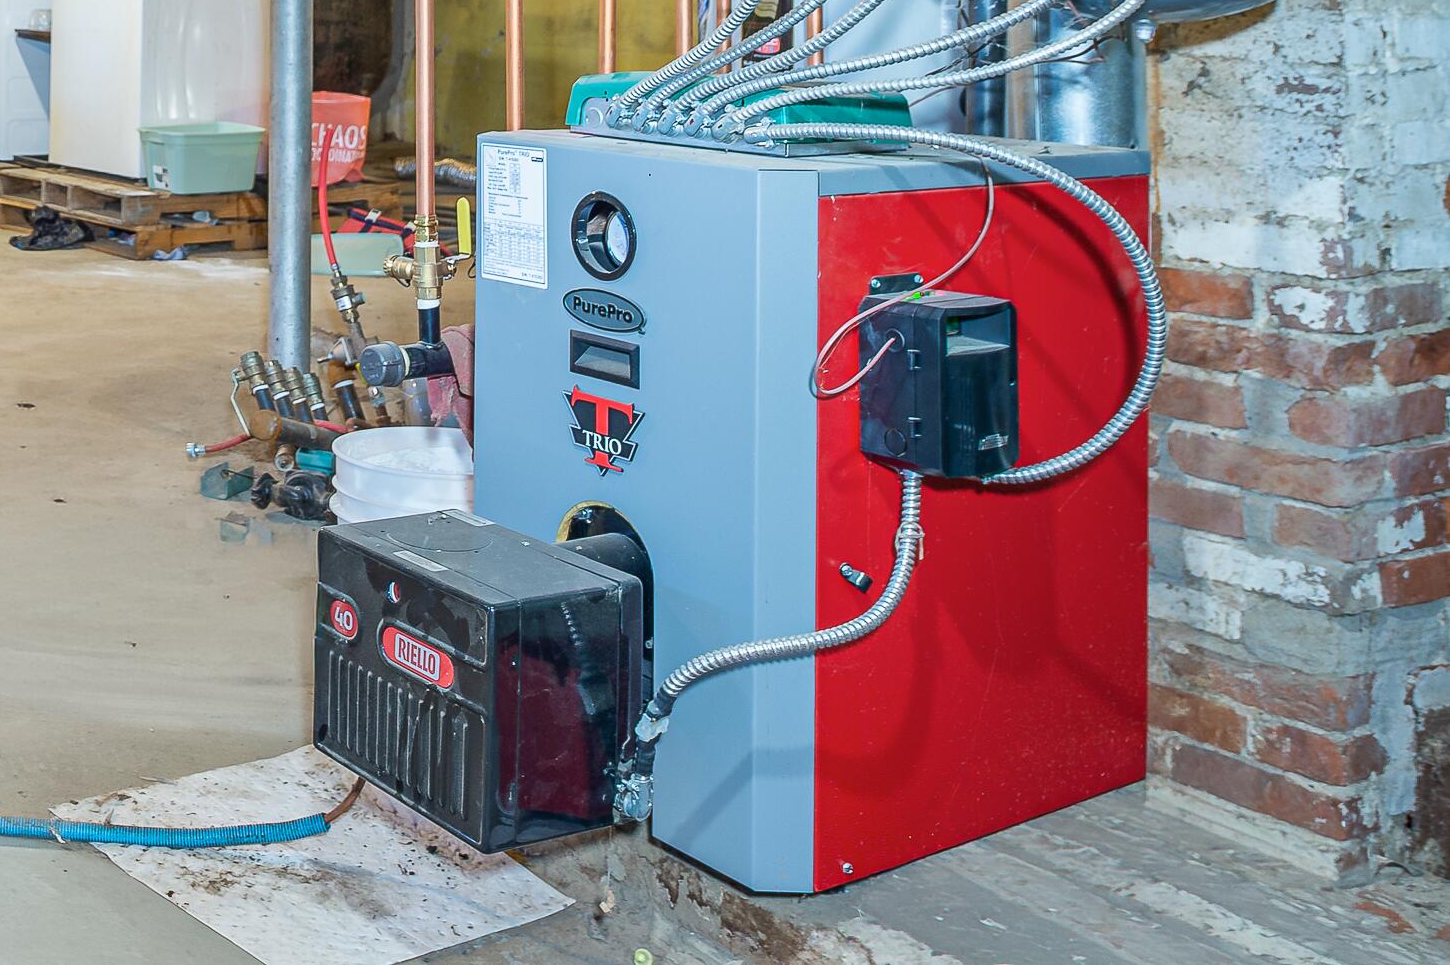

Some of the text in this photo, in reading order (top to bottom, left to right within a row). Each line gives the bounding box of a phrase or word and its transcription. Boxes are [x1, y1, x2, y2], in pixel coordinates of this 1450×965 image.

[572, 294, 634, 324] PurePro
[581, 429, 623, 456] TRIO
[334, 606, 354, 631] 40
[398, 637, 437, 675] RIELLO
